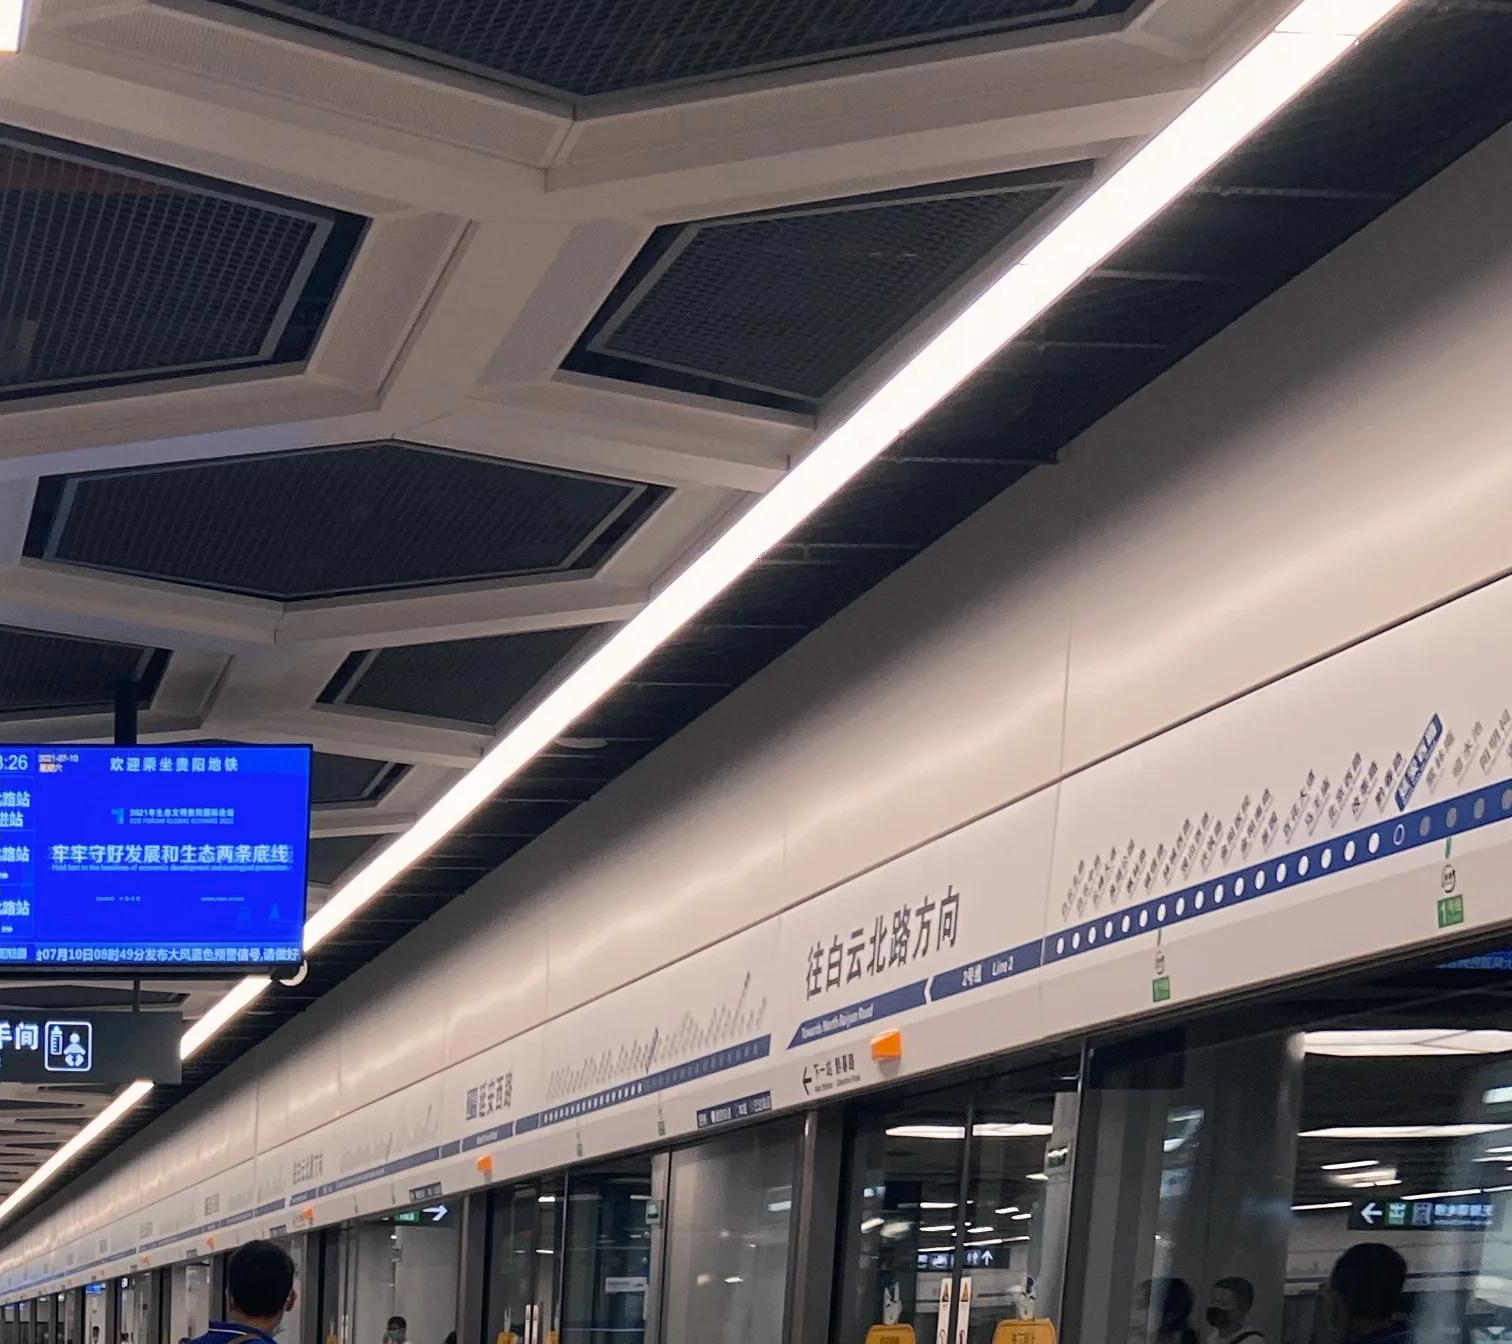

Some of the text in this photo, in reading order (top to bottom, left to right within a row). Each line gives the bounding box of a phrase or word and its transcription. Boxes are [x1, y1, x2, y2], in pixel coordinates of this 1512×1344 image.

[110, 757, 238, 772] 欢迎乘坐贵阳地铁
[51, 844, 289, 864] 牢牢守好发展和生态两条底线
[806, 885, 959, 1000] 往白云北路方向
